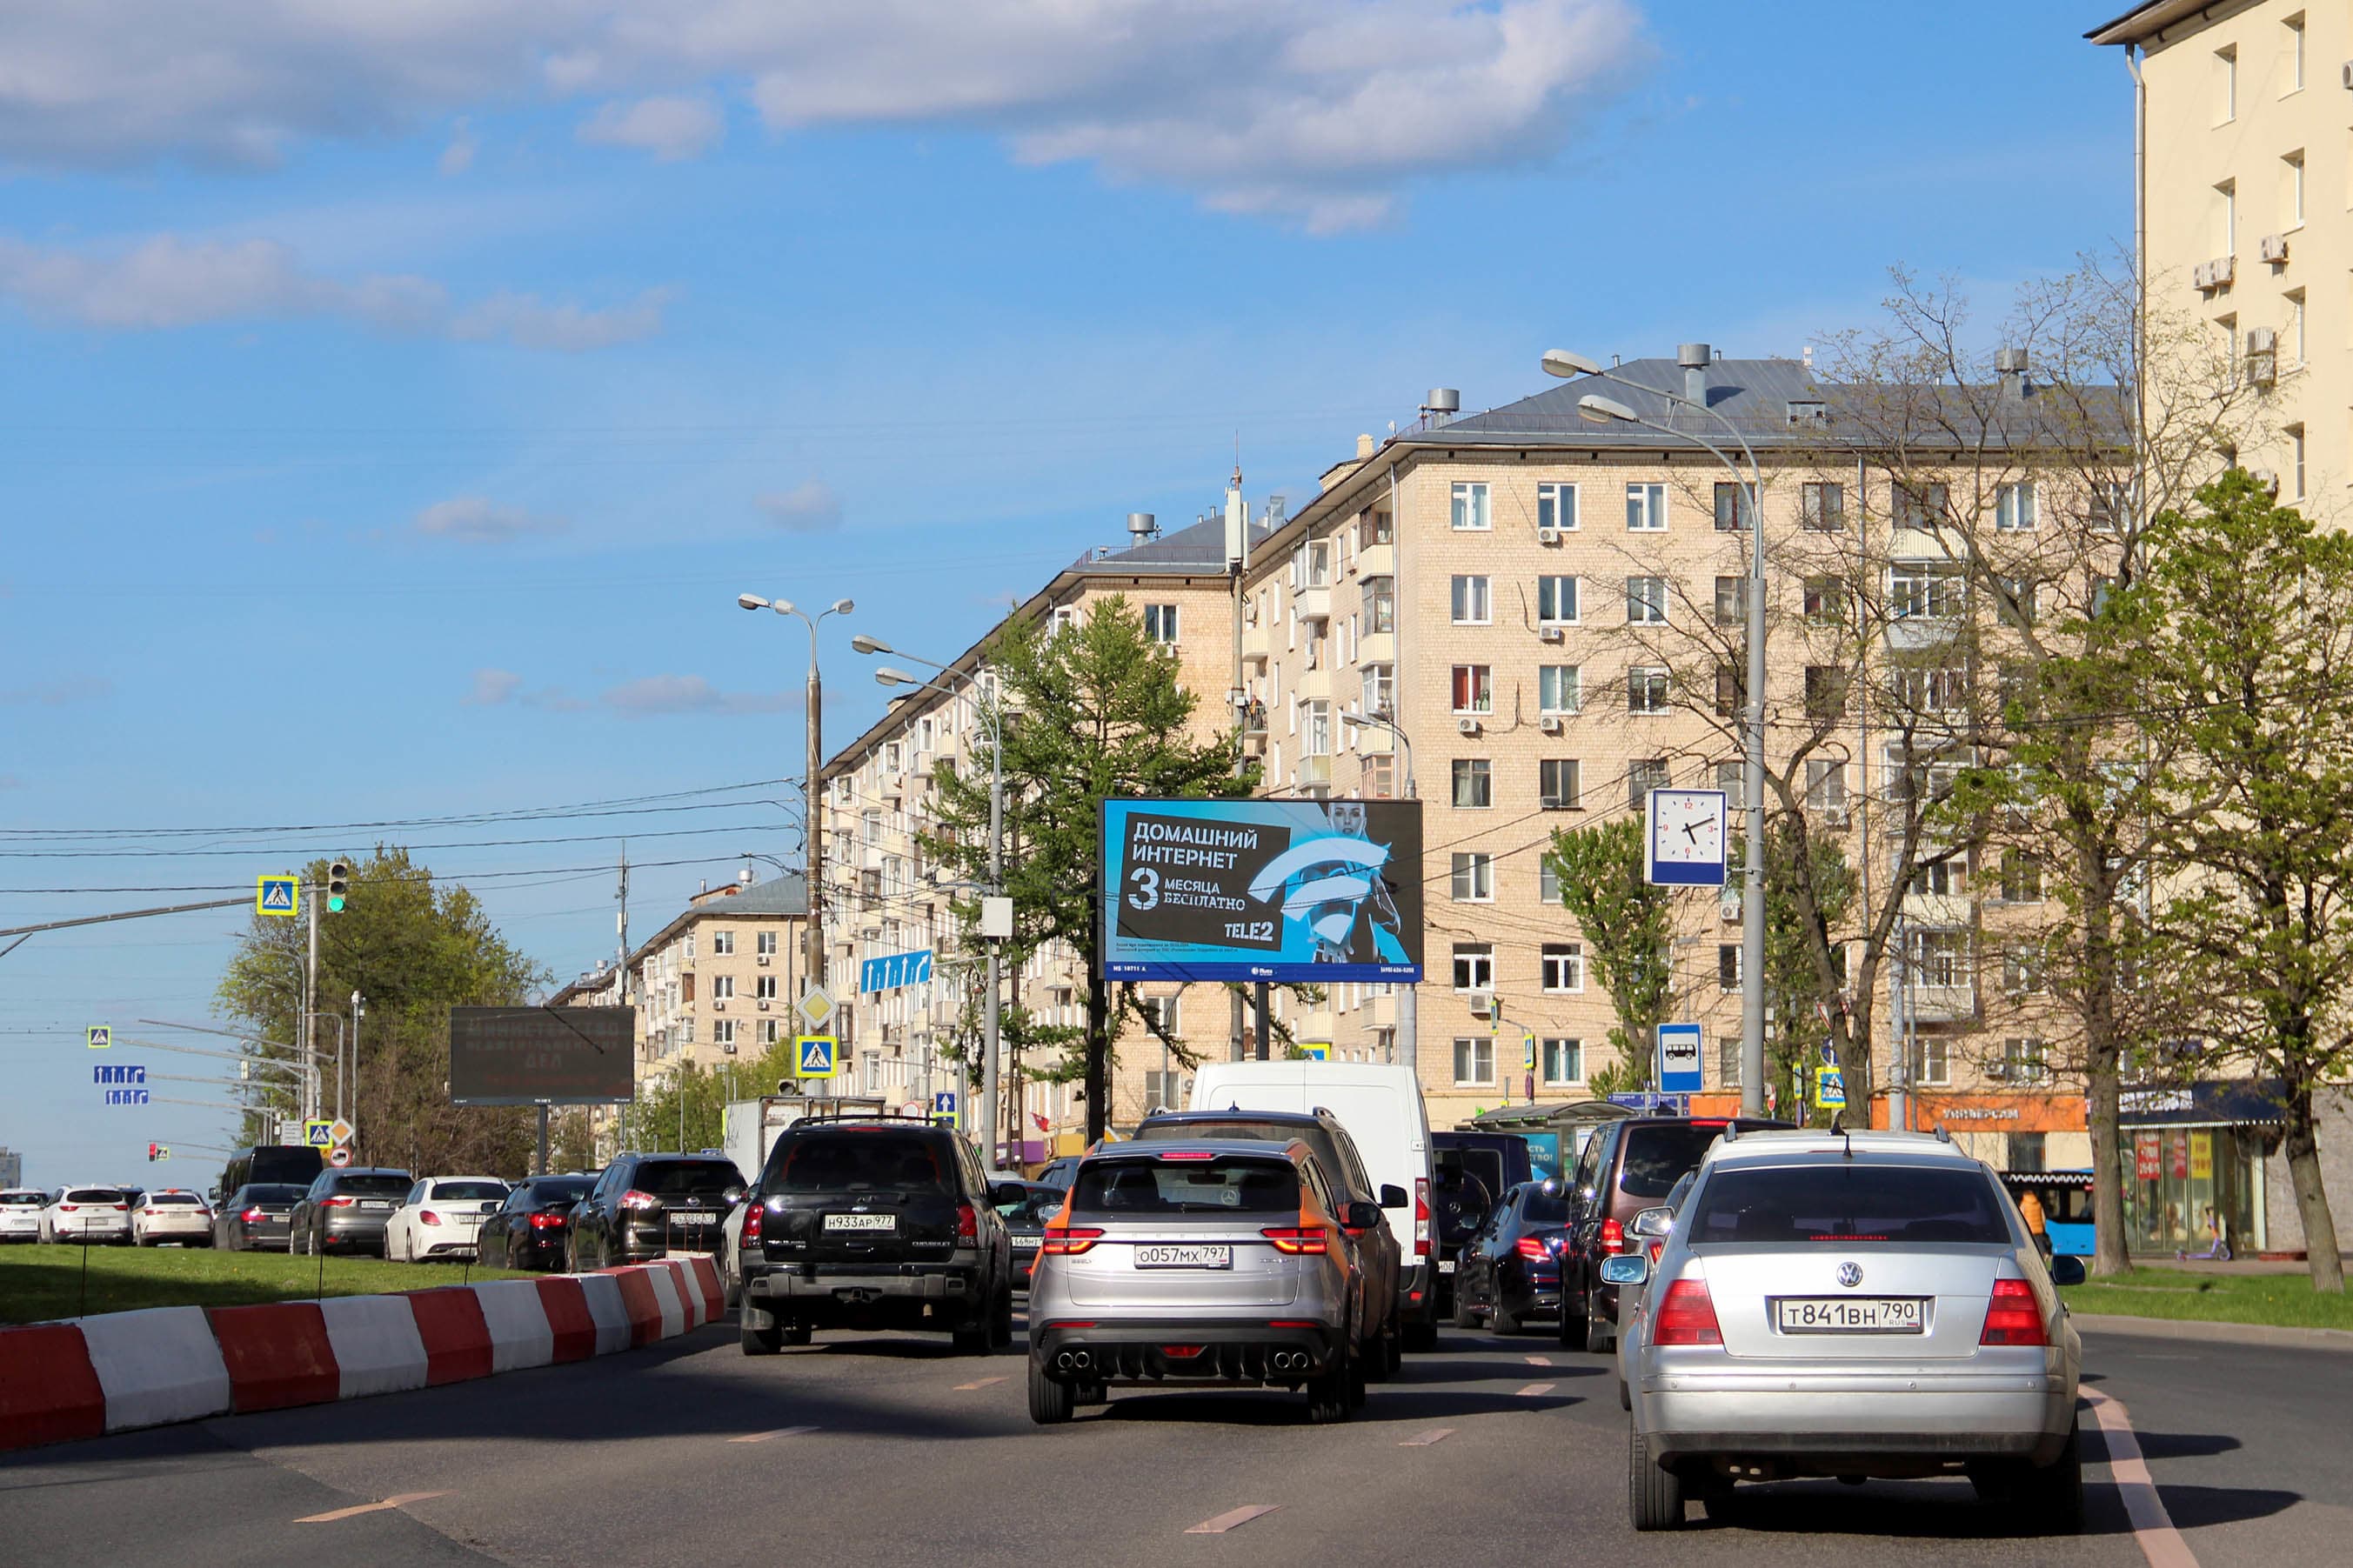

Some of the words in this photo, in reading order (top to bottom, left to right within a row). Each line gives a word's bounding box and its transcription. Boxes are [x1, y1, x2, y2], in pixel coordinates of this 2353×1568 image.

[1133, 821, 1258, 850] ДОМАШНИЙ
[1133, 844, 1238, 870] ИНТЕРНЕТ
[1128, 867, 1160, 911] 3
[1164, 877, 1220, 895] МЕСЯЦА
[1164, 891, 1246, 911] БЕСПЛАТНО
[1224, 921, 1273, 942] TELE2
[1140, 1247, 1199, 1262] О057МХ
[1788, 1304, 1875, 1324] Т841ВН
[1881, 1303, 1914, 1318] 790
